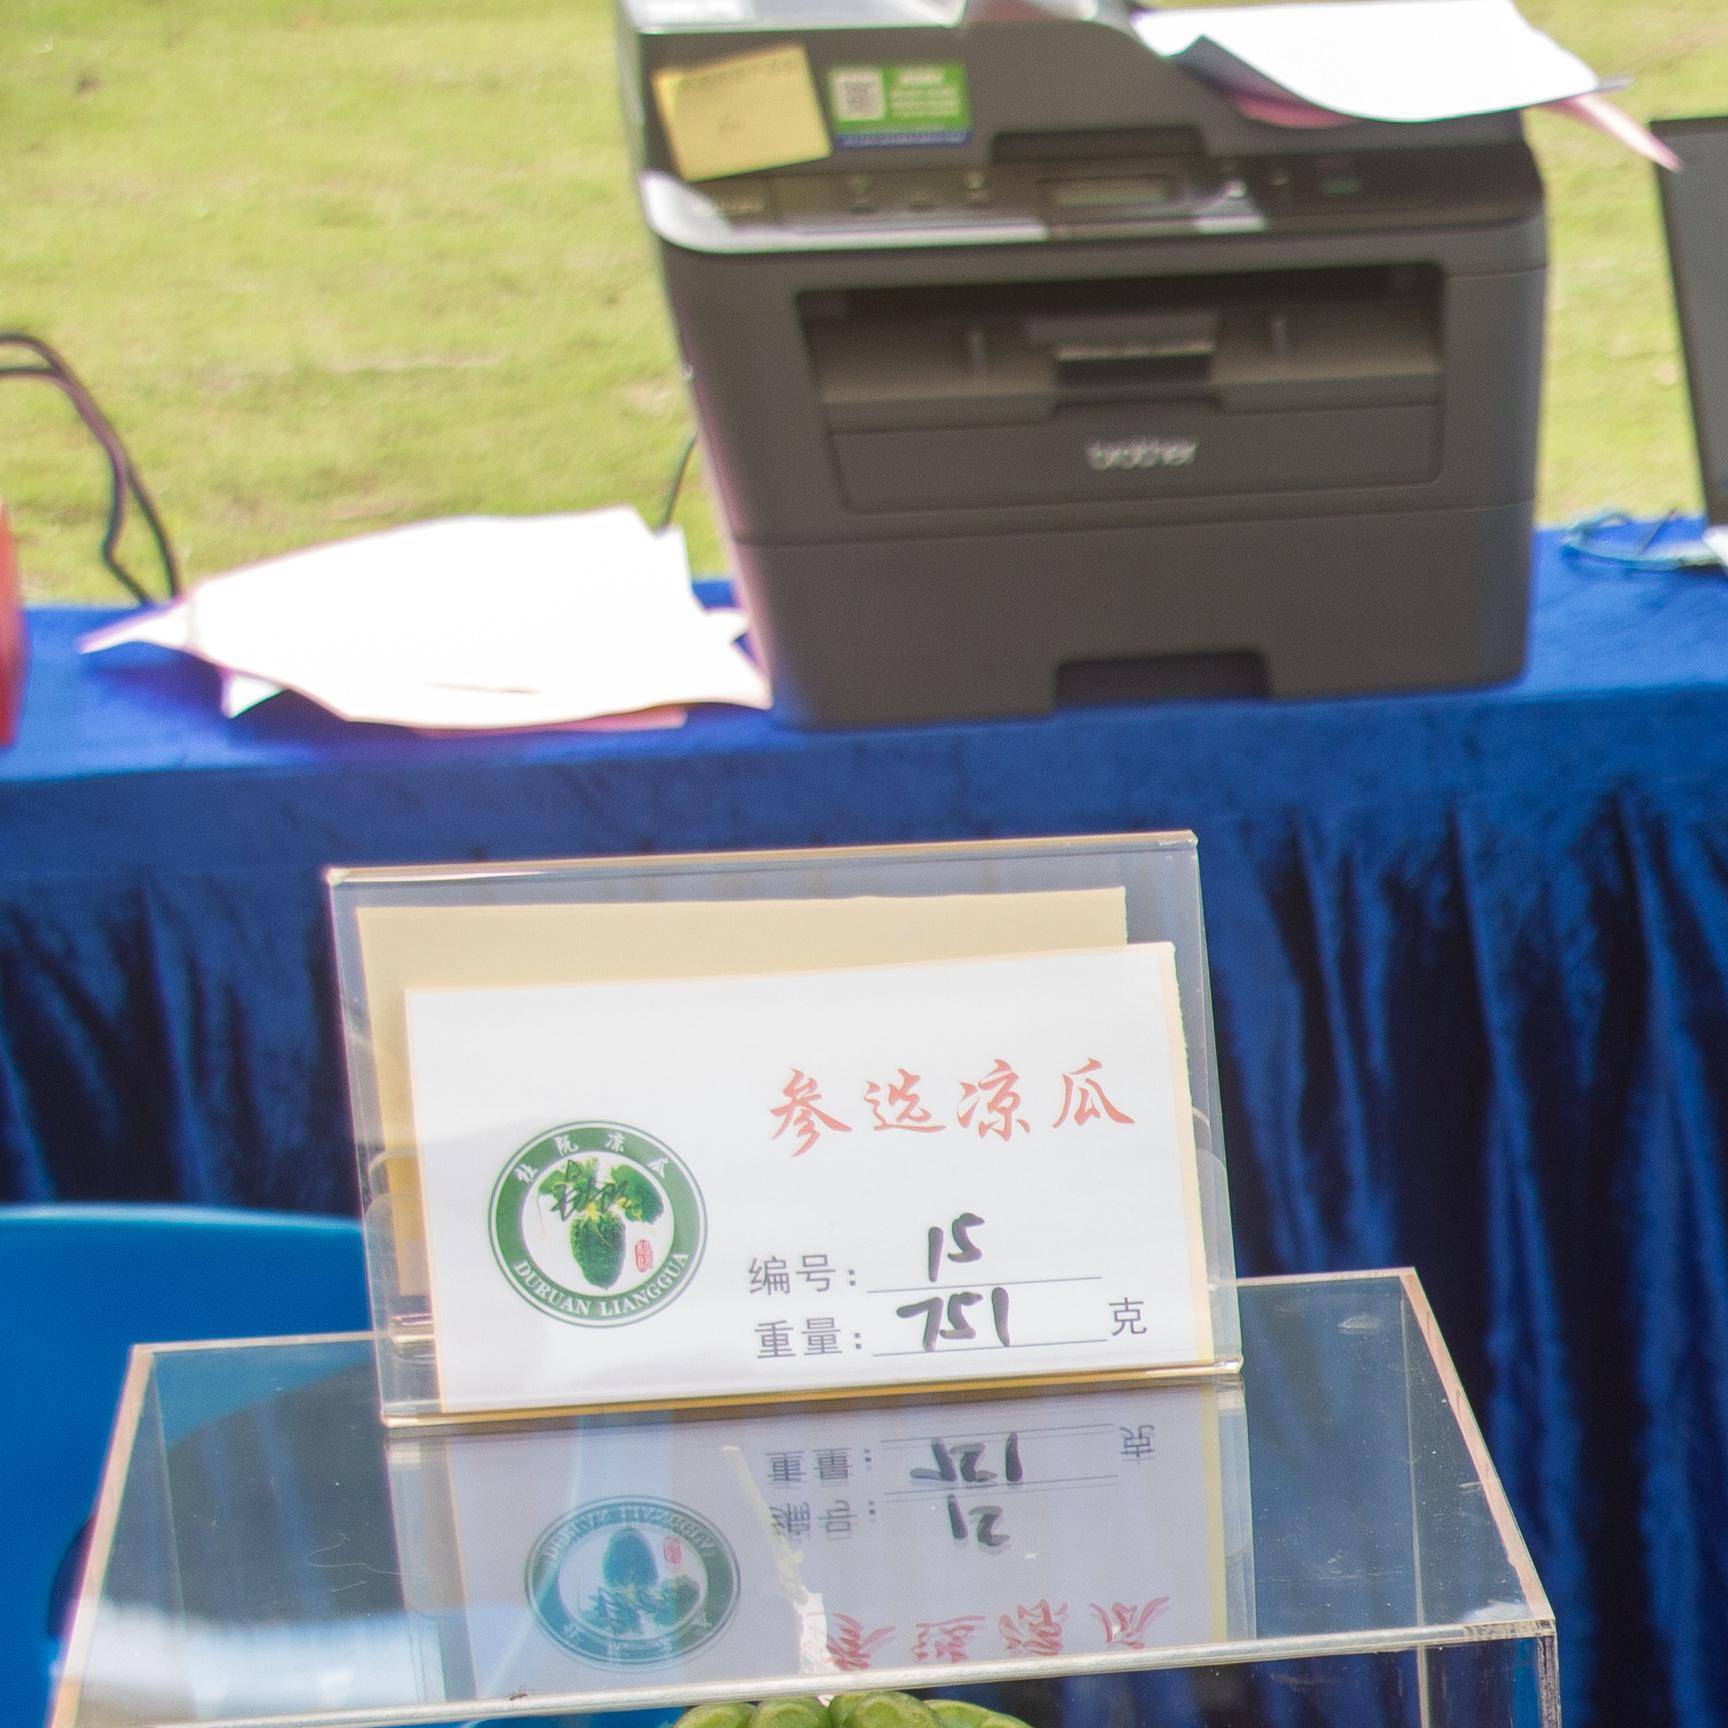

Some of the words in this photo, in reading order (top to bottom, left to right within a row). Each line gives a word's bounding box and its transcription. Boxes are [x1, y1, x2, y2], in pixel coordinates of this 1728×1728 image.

[769, 1059, 1134, 1158] 参选凉瓜
[927, 1212, 984, 1281] 15
[513, 1258, 591, 1315] DURUAN
[599, 1253, 690, 1316] LIANGGUA
[896, 1287, 1009, 1353] 751
[1109, 1298, 1148, 1338] 克
